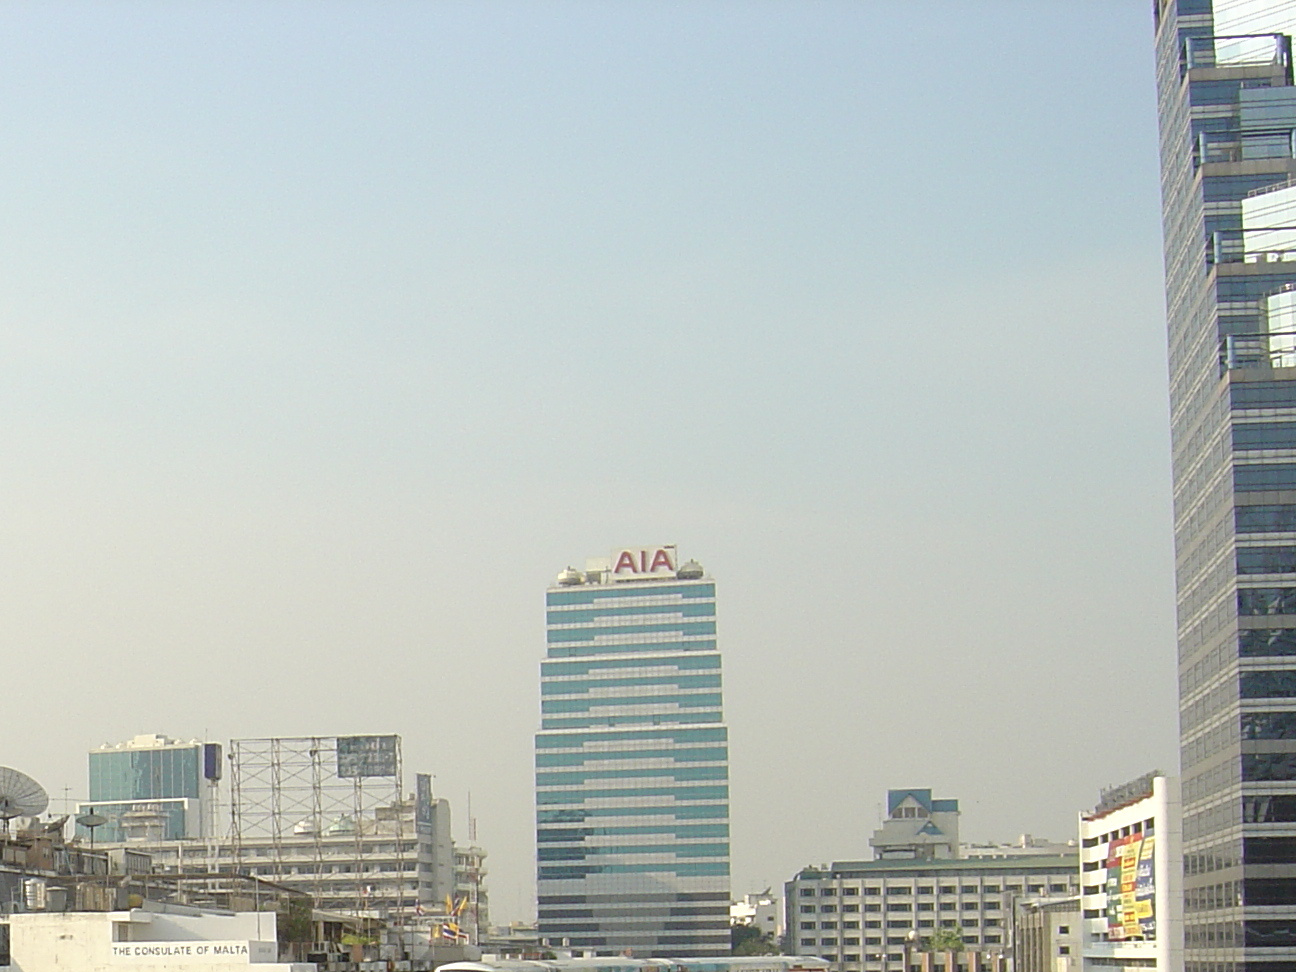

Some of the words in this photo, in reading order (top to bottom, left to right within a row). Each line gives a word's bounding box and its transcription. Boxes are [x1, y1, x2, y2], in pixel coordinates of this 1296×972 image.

[614, 549, 674, 573] AIA
[113, 947, 131, 956] THE
[134, 946, 192, 956] CONSULATE
[196, 946, 210, 955] OF
[213, 945, 248, 955] MALTA
